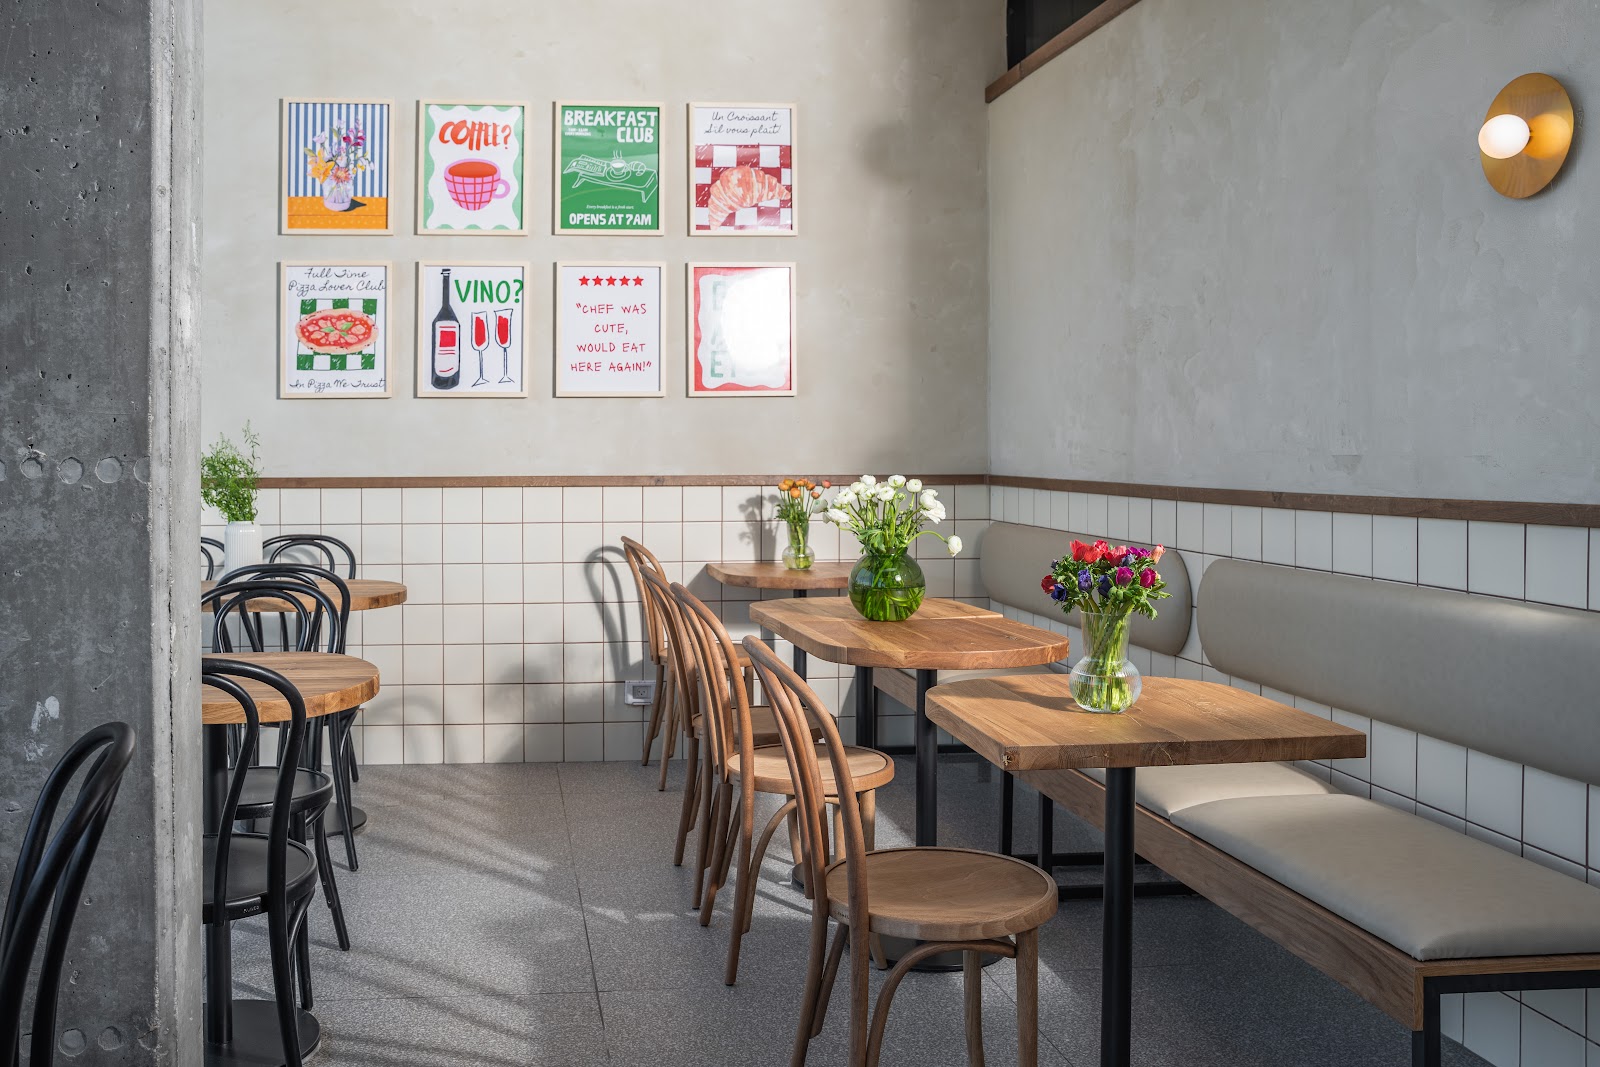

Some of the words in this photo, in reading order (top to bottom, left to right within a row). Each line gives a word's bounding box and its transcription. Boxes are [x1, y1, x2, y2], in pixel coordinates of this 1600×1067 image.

[564, 110, 658, 127] BREAKFAST
[712, 111, 724, 121] Un
[727, 111, 778, 121] Croissant
[438, 119, 512, 151] COFFEE?
[617, 127, 654, 143] CLUB
[569, 213, 606, 225] OPENS
[608, 214, 624, 225] AT
[626, 214, 652, 225] 7AM
[304, 267, 332, 279] Full
[333, 269, 369, 278] Time
[288, 280, 316, 297] Pizza
[320, 280, 353, 291] Lover
[356, 280, 386, 291] Club
[454, 279, 524, 304] VINO?
[576, 302, 614, 314] "CHEF
[621, 303, 647, 314] WAS
[594, 323, 628, 335] CUTE,
[576, 342, 615, 353] WOULD
[622, 342, 645, 353] EAT
[570, 362, 601, 372] HERE
[608, 361, 652, 372] AGAIN!"
[289, 379, 305, 389] In
[307, 379, 332, 393] Pizza
[333, 379, 349, 388] We
[351, 378, 386, 388] Trust
